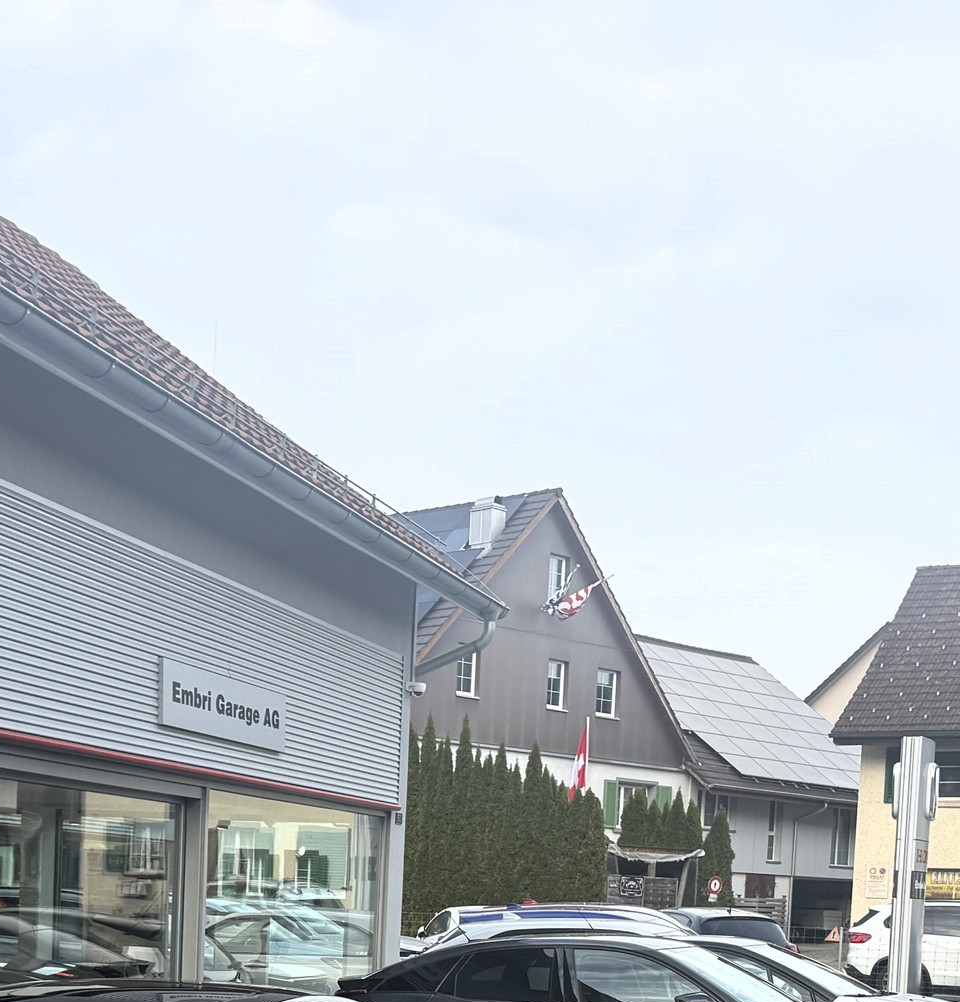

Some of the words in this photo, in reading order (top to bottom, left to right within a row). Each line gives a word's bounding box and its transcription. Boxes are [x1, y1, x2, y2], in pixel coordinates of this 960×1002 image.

[172, 681, 212, 711] Embri
[215, 694, 260, 726] Garage
[263, 708, 280, 729] AG
